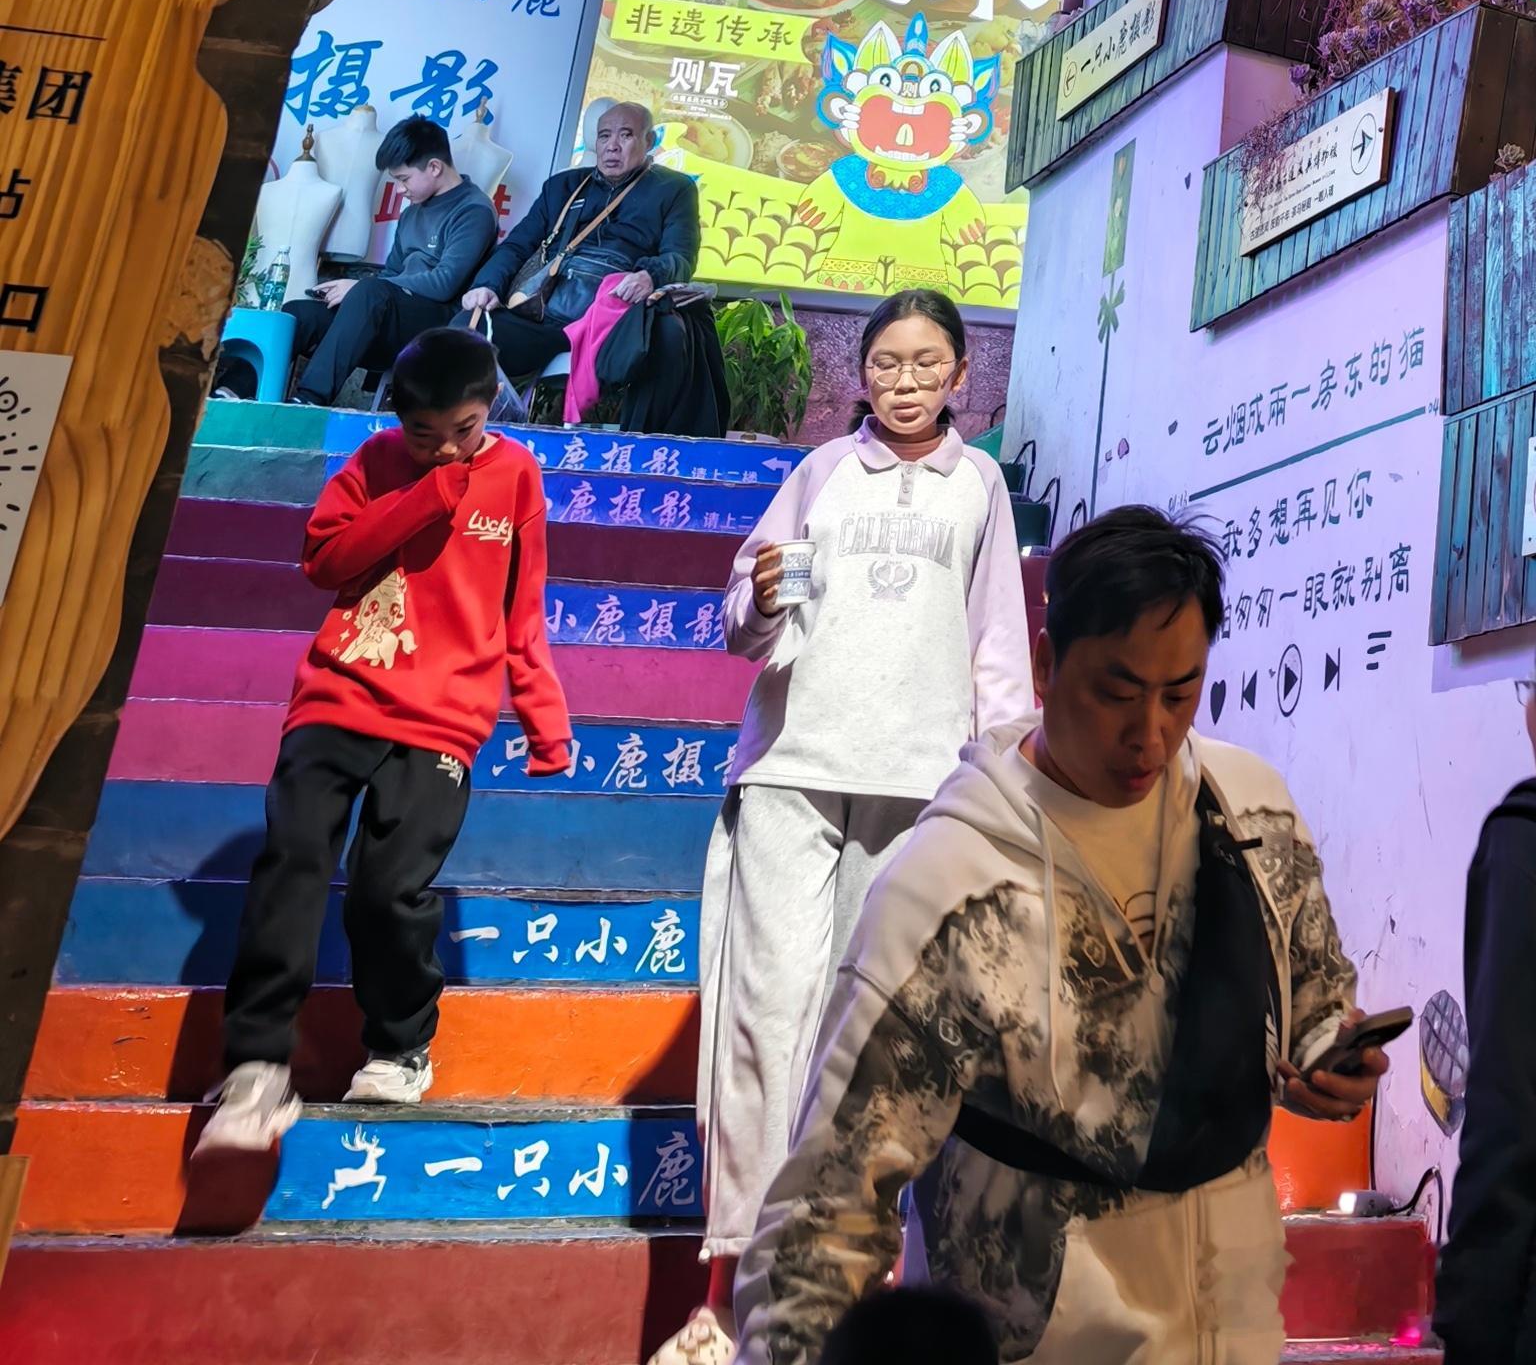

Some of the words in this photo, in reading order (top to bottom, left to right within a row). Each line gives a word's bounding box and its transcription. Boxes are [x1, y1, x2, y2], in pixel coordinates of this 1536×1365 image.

[626, 4, 794, 54] 非遗传承
[1080, 0, 1156, 75] 一只小鹿摄影
[283, 30, 499, 127] 摄影
[664, 57, 741, 99] 则瓦
[901, 80, 917, 98] 则
[467, 509, 513, 547] Lucky
[546, 480, 692, 530] 鹿摄影
[703, 511, 764, 532] 请上二
[1222, 470, 1374, 559] 我多想再见你
[838, 515, 957, 570] CALIFORNIA
[449, 909, 686, 974] 一只小鹿
[424, 1131, 697, 1207] 一只小鹿
